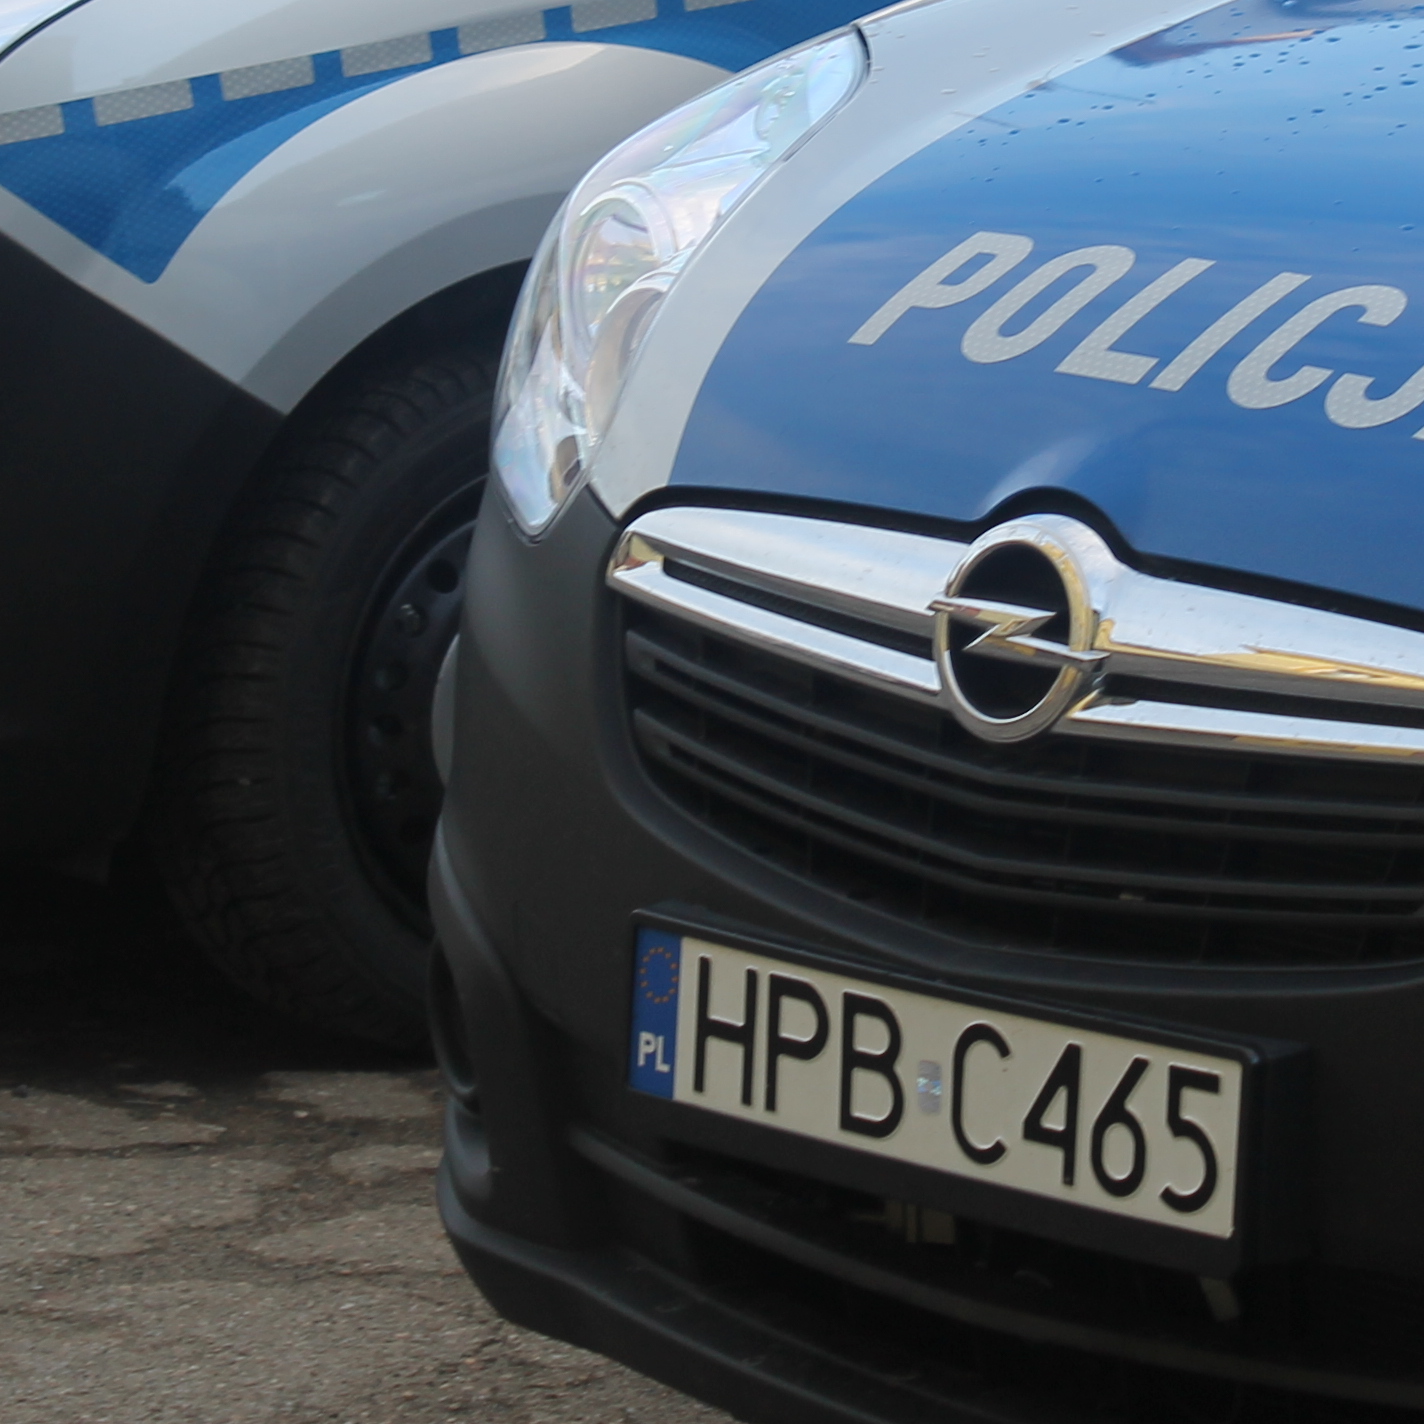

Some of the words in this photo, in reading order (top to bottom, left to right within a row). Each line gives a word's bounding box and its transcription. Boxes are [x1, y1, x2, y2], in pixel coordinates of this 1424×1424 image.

[637, 1032, 671, 1073] PL
[692, 955, 905, 1139] HPB
[950, 1022, 1221, 1214] C465
